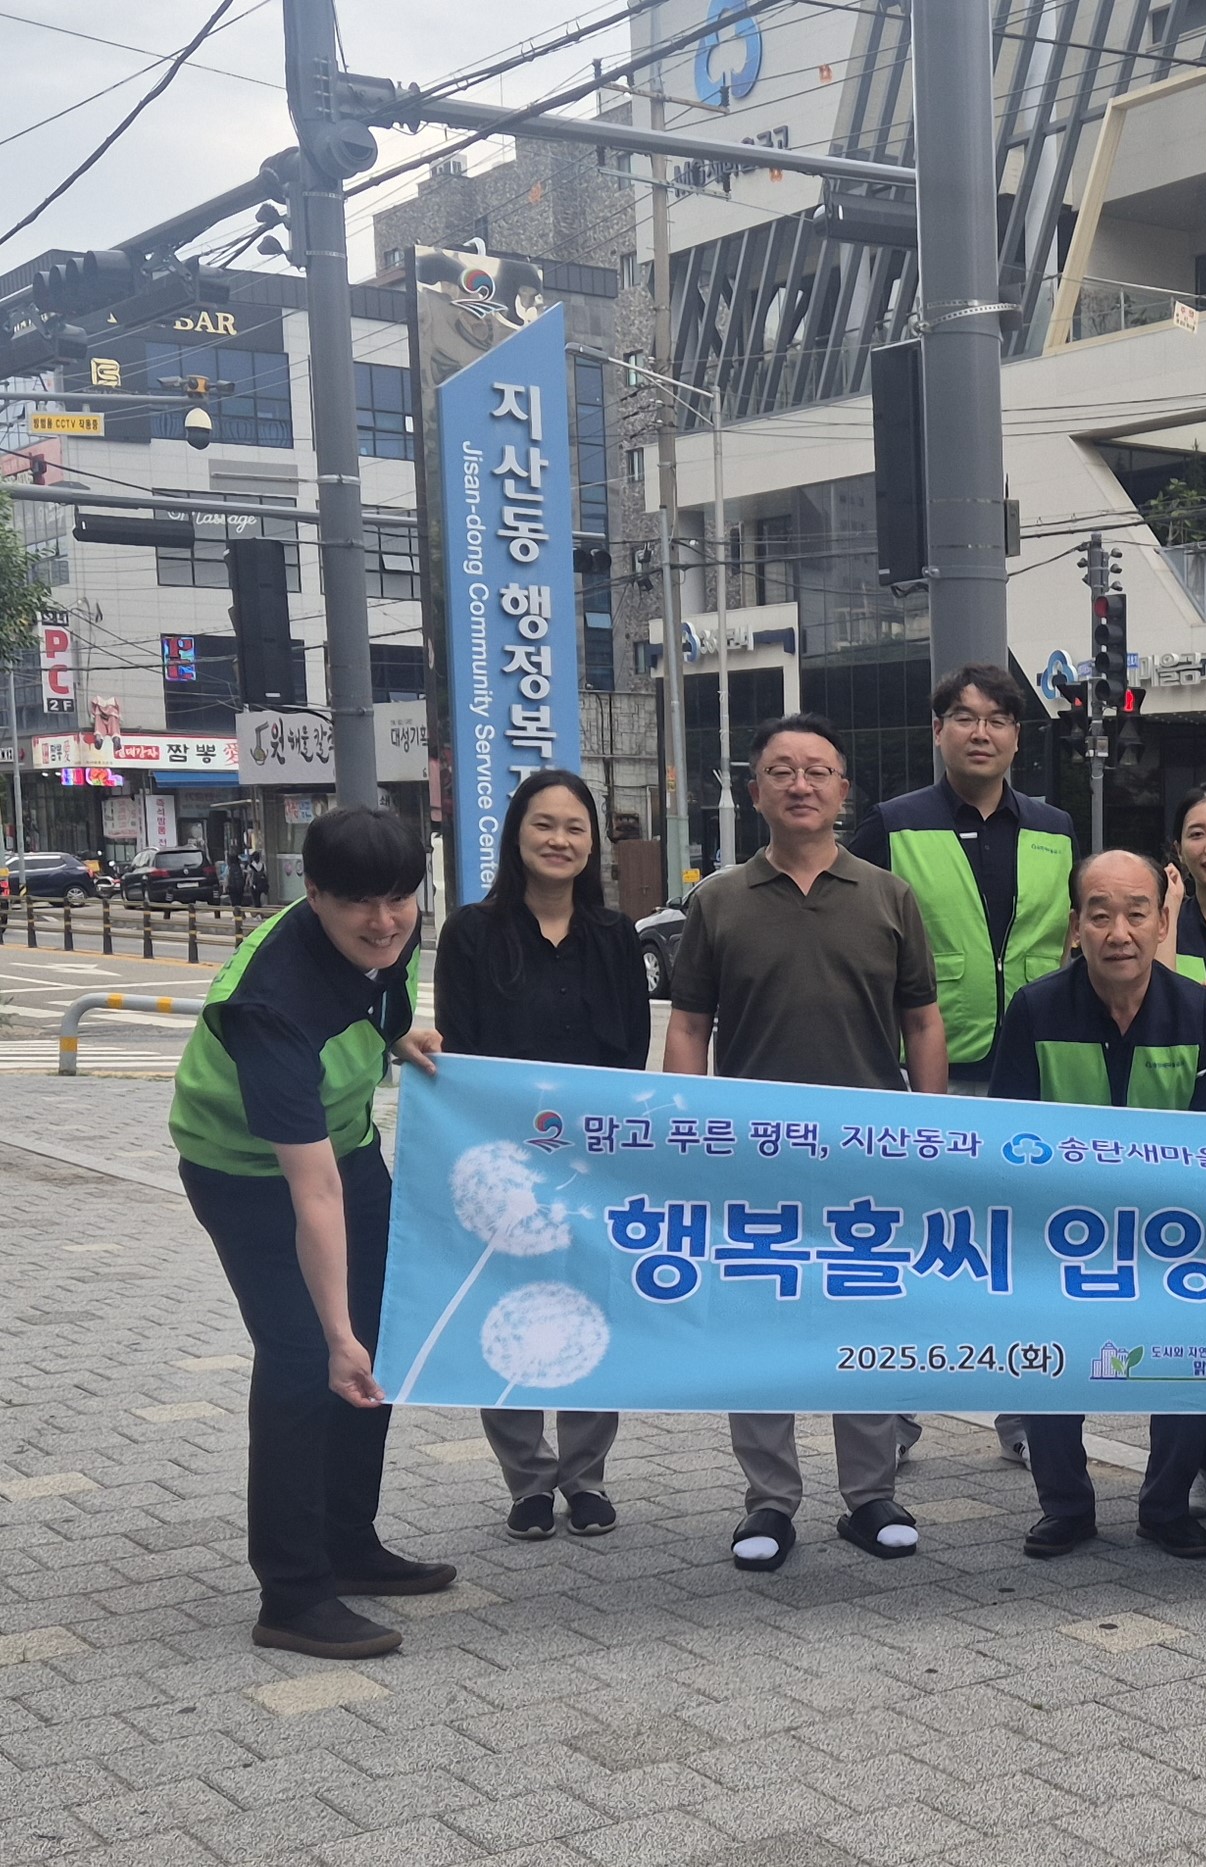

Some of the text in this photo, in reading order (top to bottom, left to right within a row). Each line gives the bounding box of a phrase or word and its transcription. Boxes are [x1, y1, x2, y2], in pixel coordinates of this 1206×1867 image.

[173, 311, 237, 335] BAR
[56, 419, 76, 428] CCTV
[490, 381, 550, 562] 지산동
[45, 629, 70, 695] PC
[462, 440, 495, 891] Jisan-dong Community Service Center
[50, 700, 72, 711] 2F
[167, 743, 217, 764] 짬뽕
[584, 1116, 656, 1154] 맑고
[668, 1117, 737, 1156] 푸른
[749, 1120, 828, 1160] 평택,
[841, 1123, 983, 1160] 지산동과
[607, 1196, 1010, 1303] 행복홀씨
[838, 1343, 1066, 1379] 2025.6.24.(화)
[1152, 1346, 1183, 1358] 도시와
